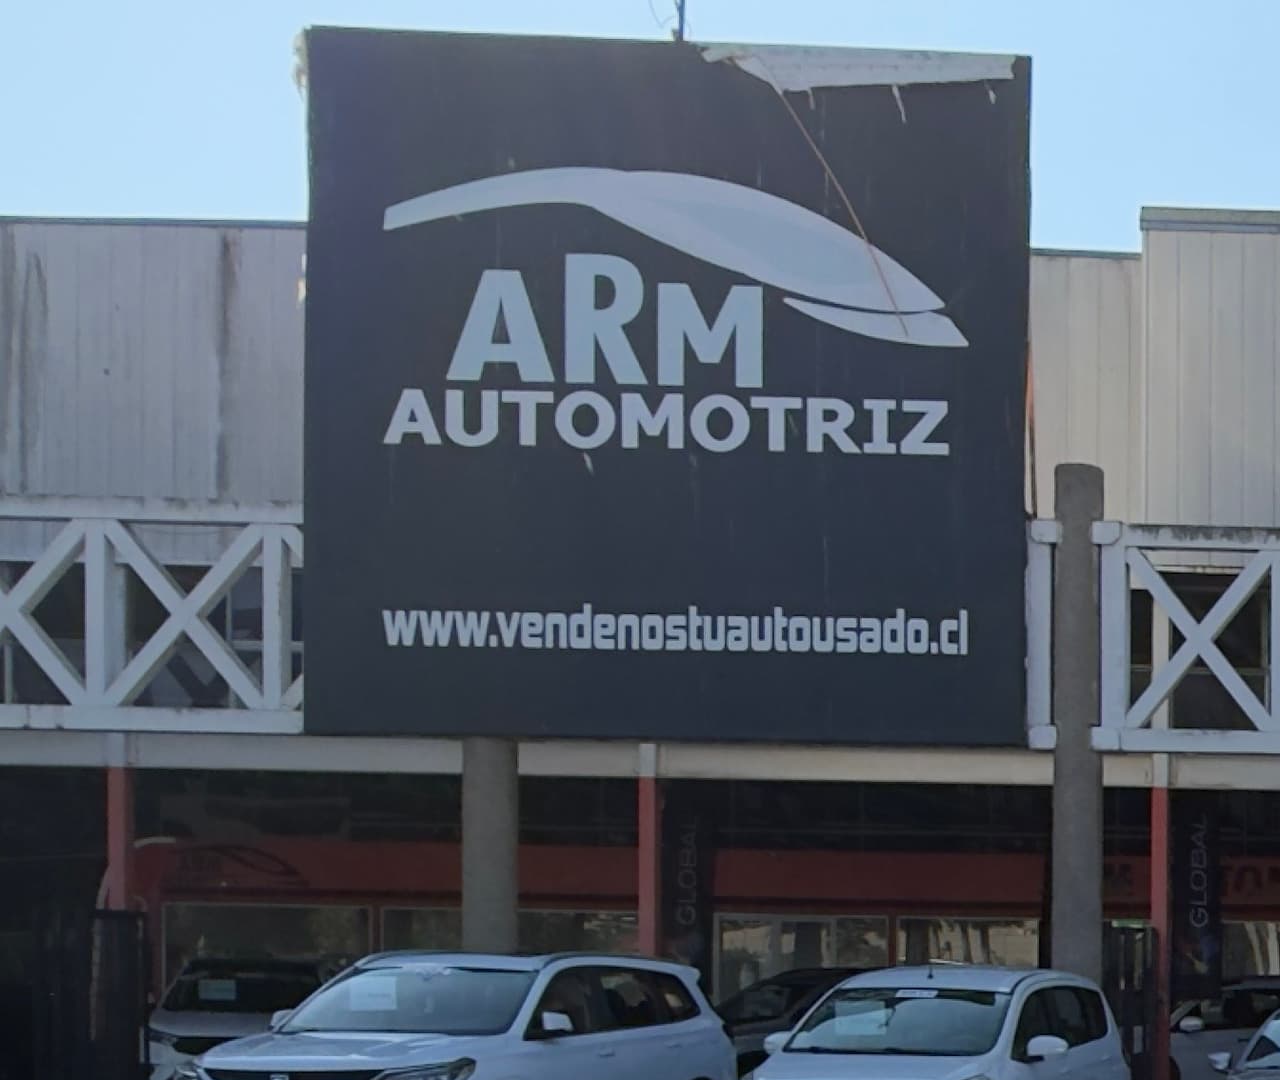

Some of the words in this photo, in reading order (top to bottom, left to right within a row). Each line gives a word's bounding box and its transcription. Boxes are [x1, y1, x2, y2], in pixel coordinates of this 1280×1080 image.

[445, 252, 763, 388] ARM
[382, 388, 950, 456] AUTOMOTRIZ
[382, 603, 968, 656] www.vendenostuautousado.cl
[1188, 811, 1209, 930] GLOBAL
